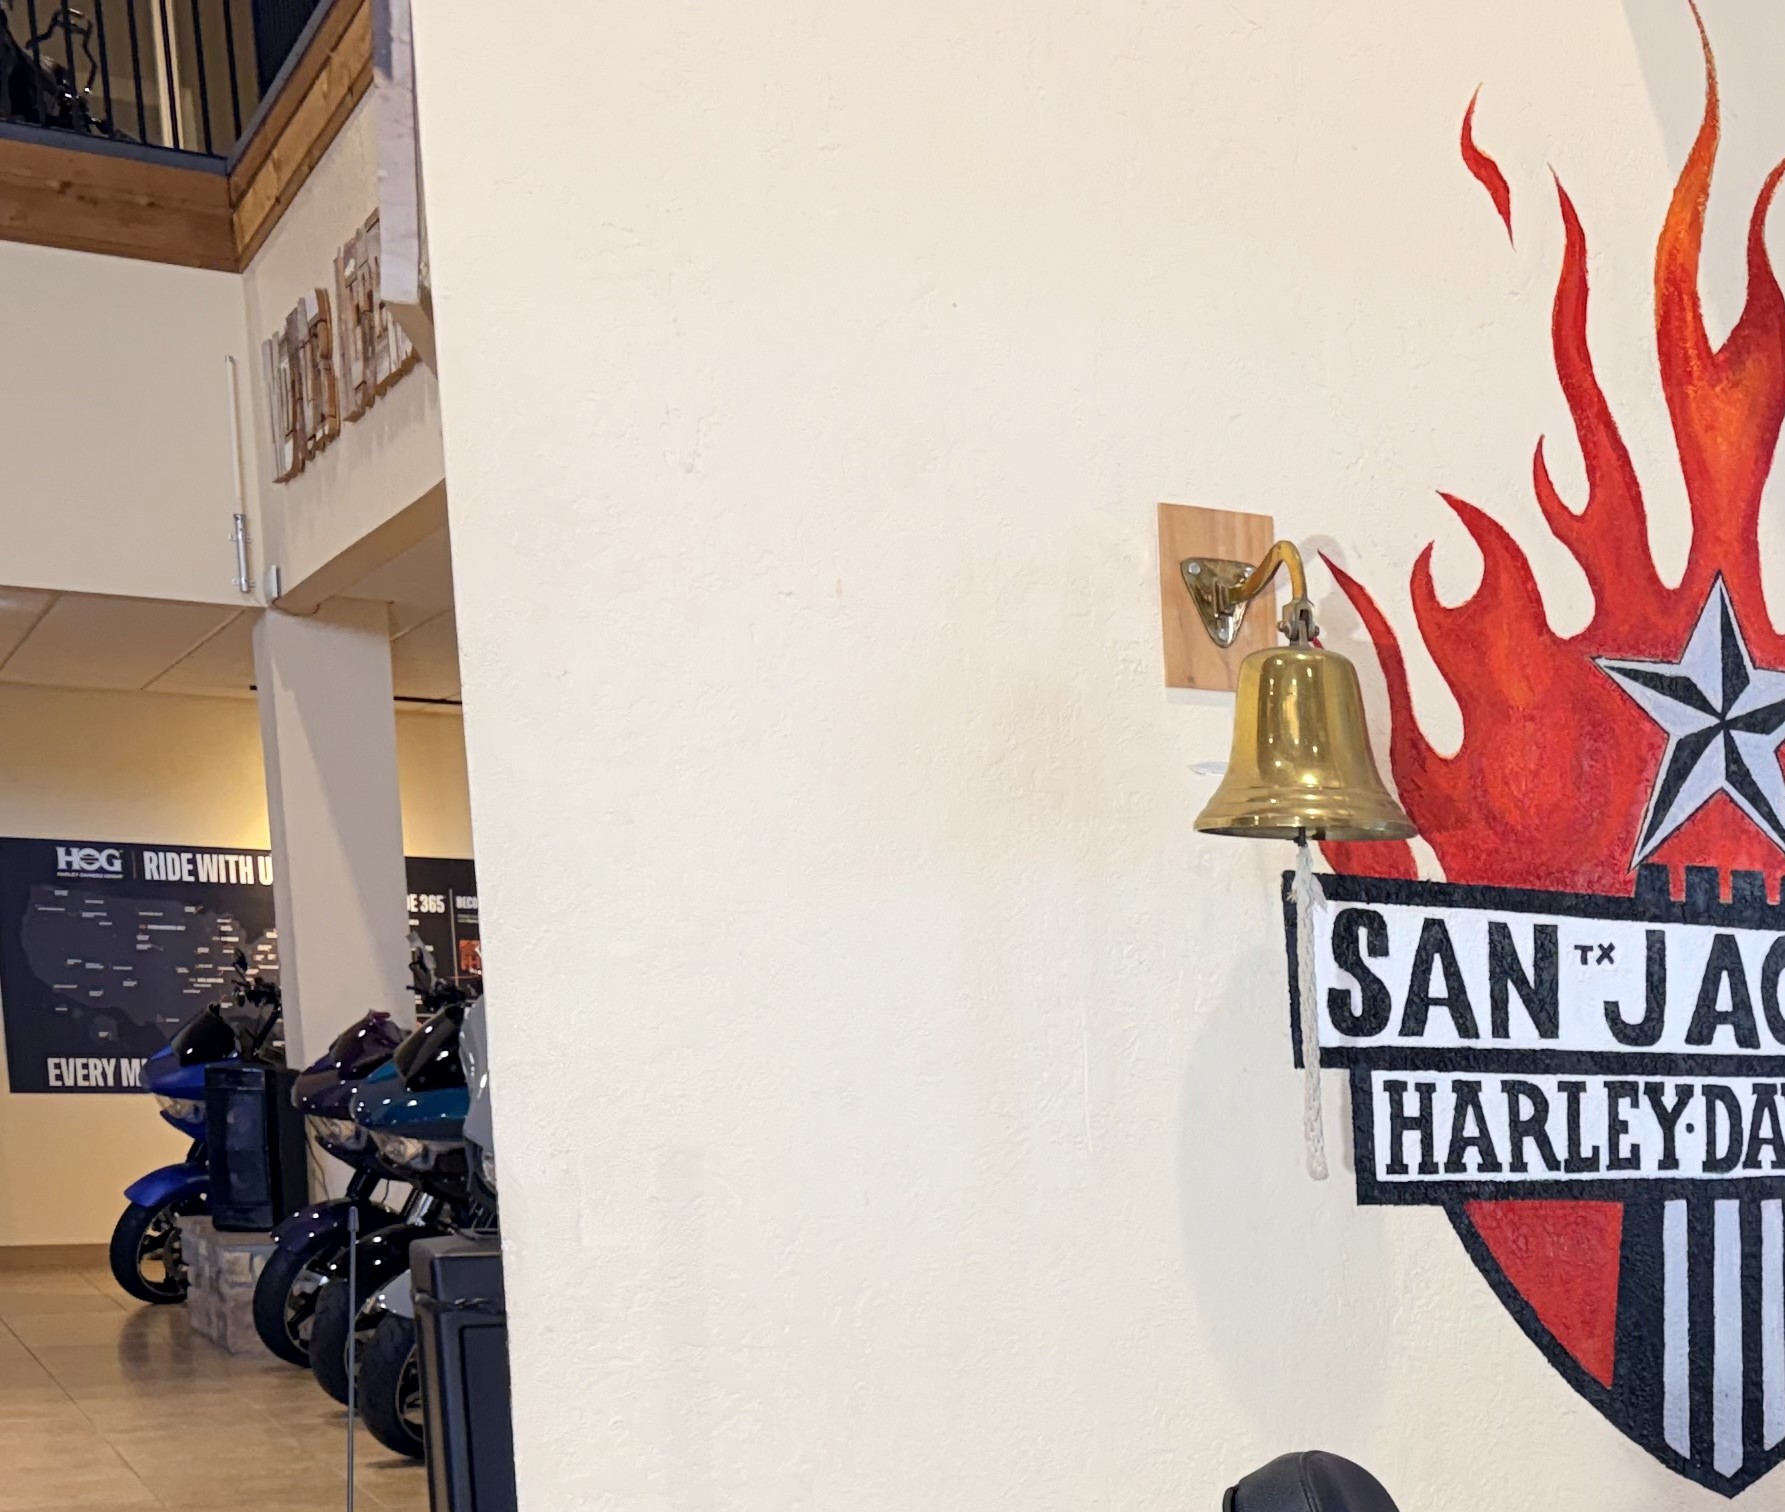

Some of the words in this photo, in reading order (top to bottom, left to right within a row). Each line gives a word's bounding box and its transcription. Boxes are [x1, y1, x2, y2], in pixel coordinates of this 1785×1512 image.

[56, 846, 122, 872] HOG
[143, 851, 195, 881] RIDE
[196, 853, 255, 885] WITH
[419, 893, 445, 913] 365
[1327, 907, 1560, 1040] SAN
[1574, 941, 1616, 967] TX
[46, 1057, 116, 1087] EVERY
